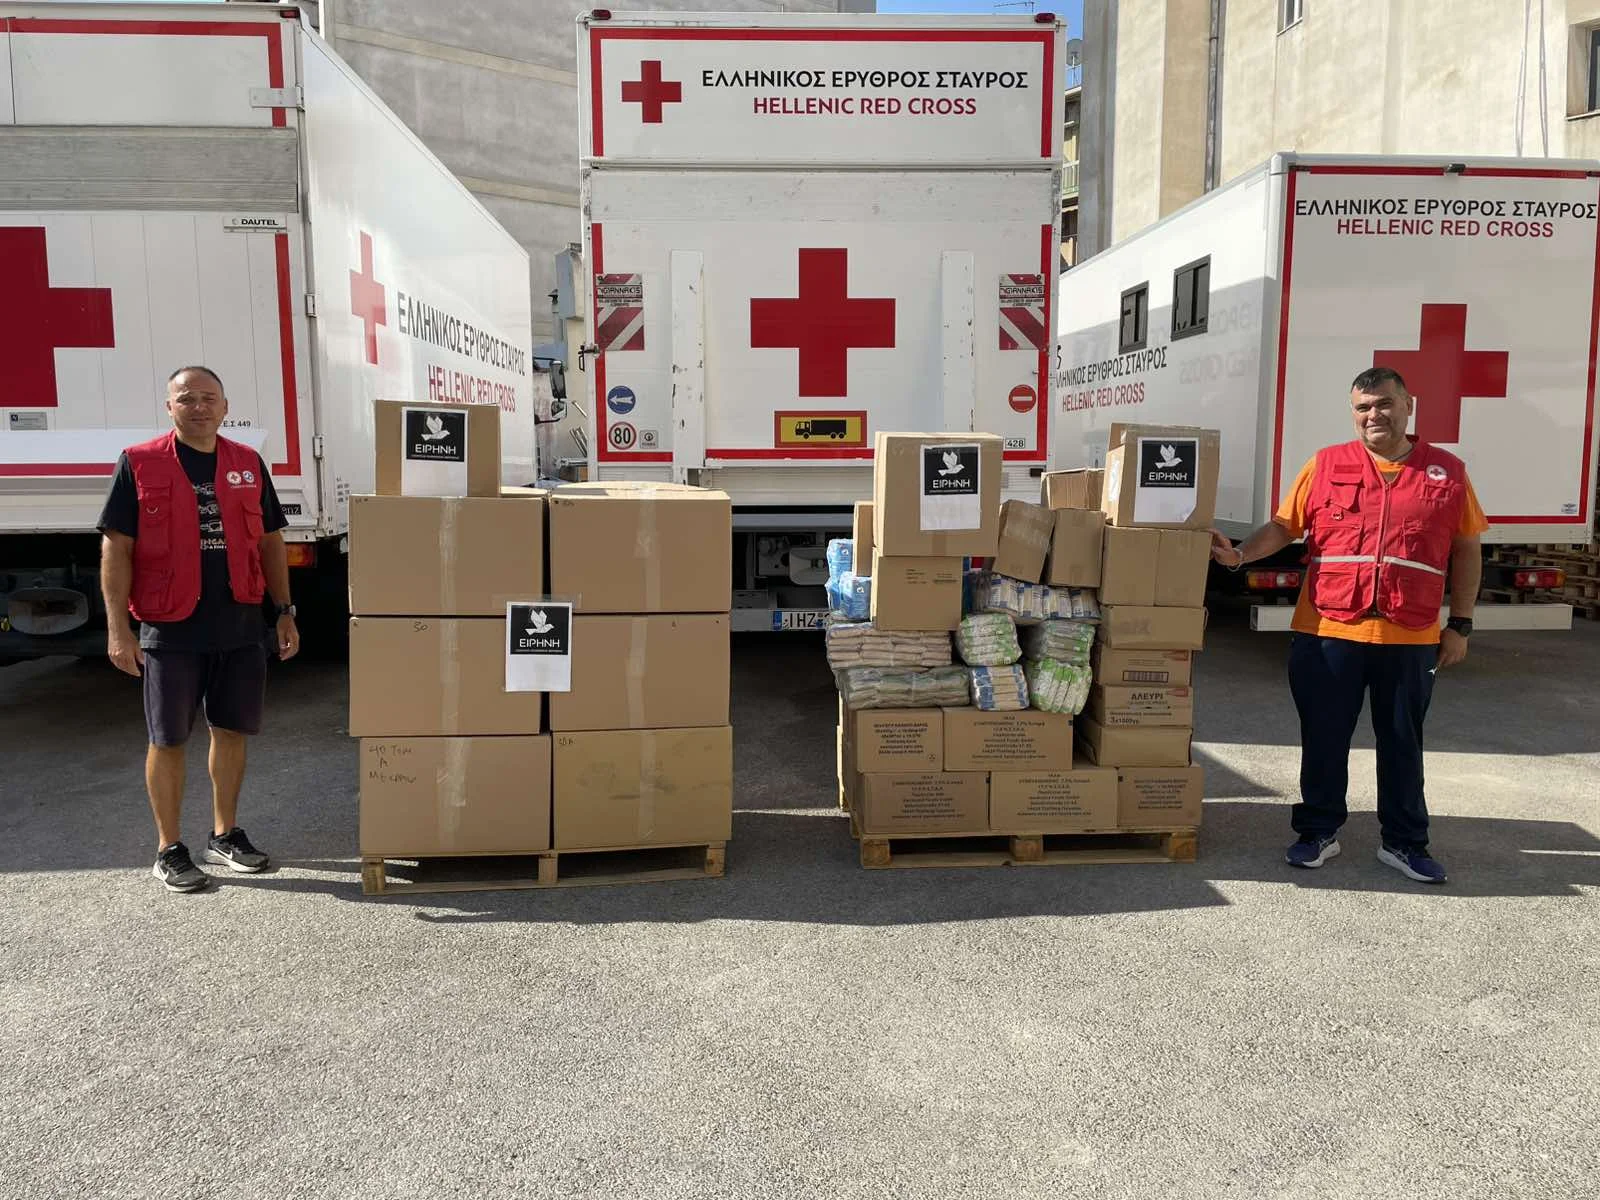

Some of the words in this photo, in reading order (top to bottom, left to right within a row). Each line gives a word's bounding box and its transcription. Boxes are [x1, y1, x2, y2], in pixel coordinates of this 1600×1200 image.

[702, 70, 826, 88] ΕΛΛΗΝΙΚΟΣ
[832, 70, 930, 88] ΕΡΥΘΡΟΣ
[936, 71, 1029, 89] ΣΤΑΥΡΟΣ
[753, 97, 854, 115] HELLENIC
[860, 97, 902, 115] RED
[908, 97, 977, 115] CROSS
[1295, 199, 1409, 216] ΕΛΛΗΝΙΚΟΣ
[1414, 199, 1506, 217] ΕΡΥΘΡΟΣ
[1512, 201, 1598, 219] ΣΤΑΥΡΟΣ
[241, 218, 279, 226] DAUTEL
[1337, 218, 1434, 236] HELLENIC
[1440, 219, 1480, 236] RED
[1486, 220, 1554, 238] CROSS
[397, 291, 462, 355] ΕΛΛΗΝΙΚΟΣ
[463, 321, 500, 368] ΕΡΥΘΡΟΣ
[500, 339, 526, 377] ΣΤΑΥΡΟΣ
[1087, 356, 1124, 383] ΕΡΥΘΡΟΣ
[1125, 345, 1168, 376] ΣΤΑΥΡΟΣ
[427, 363, 476, 404] HELLENIC
[476, 377, 492, 404] RED
[494, 383, 516, 413] CROSS
[1062, 389, 1095, 413] HELLENIC
[1096, 387, 1113, 408] RED
[1114, 381, 1145, 406] CROSS
[614, 427, 632, 445] 80
[1007, 439, 1024, 448] 428
[415, 443, 457, 456] ΕΙΡΗΝΗ
[932, 479, 970, 489] ΕΙΡΗΝΗ
[1148, 471, 1188, 481] ΕΙΡΗΝΗ
[519, 638, 560, 648] ΕΙΡΗΝΗ
[1131, 692, 1164, 701] ΑΛΕΥΡΙ
